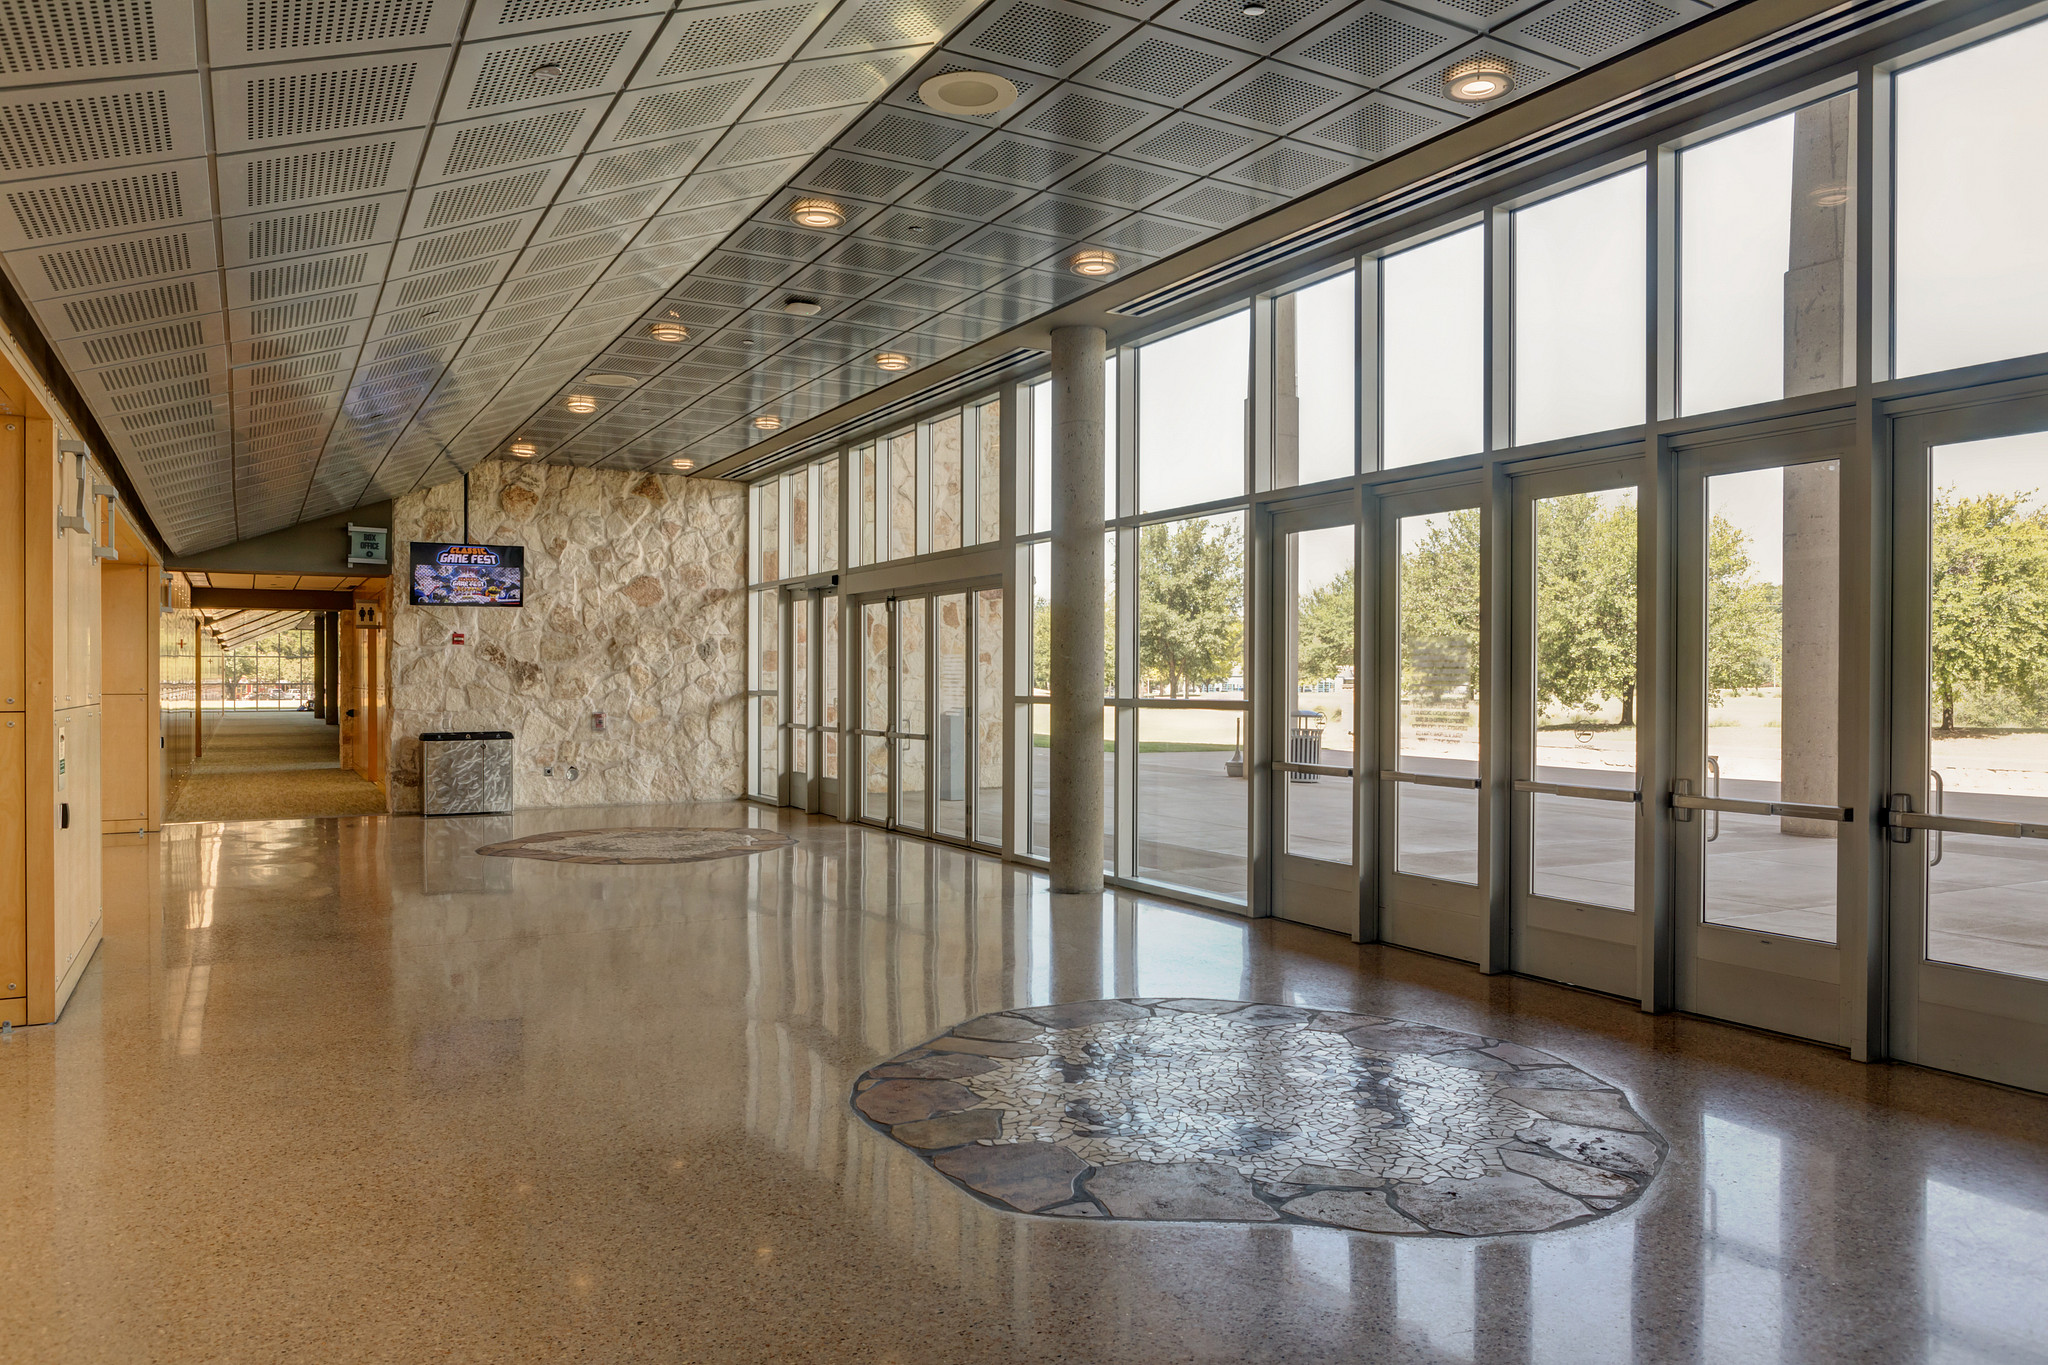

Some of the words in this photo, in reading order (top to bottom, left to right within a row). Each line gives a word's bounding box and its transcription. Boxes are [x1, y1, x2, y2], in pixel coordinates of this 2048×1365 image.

[363, 533, 376, 541] BOX
[360, 542, 380, 550] OFFICE
[450, 547, 487, 555] CLASSIC
[440, 553, 469, 564] GAME
[471, 554, 496, 565] FEST
